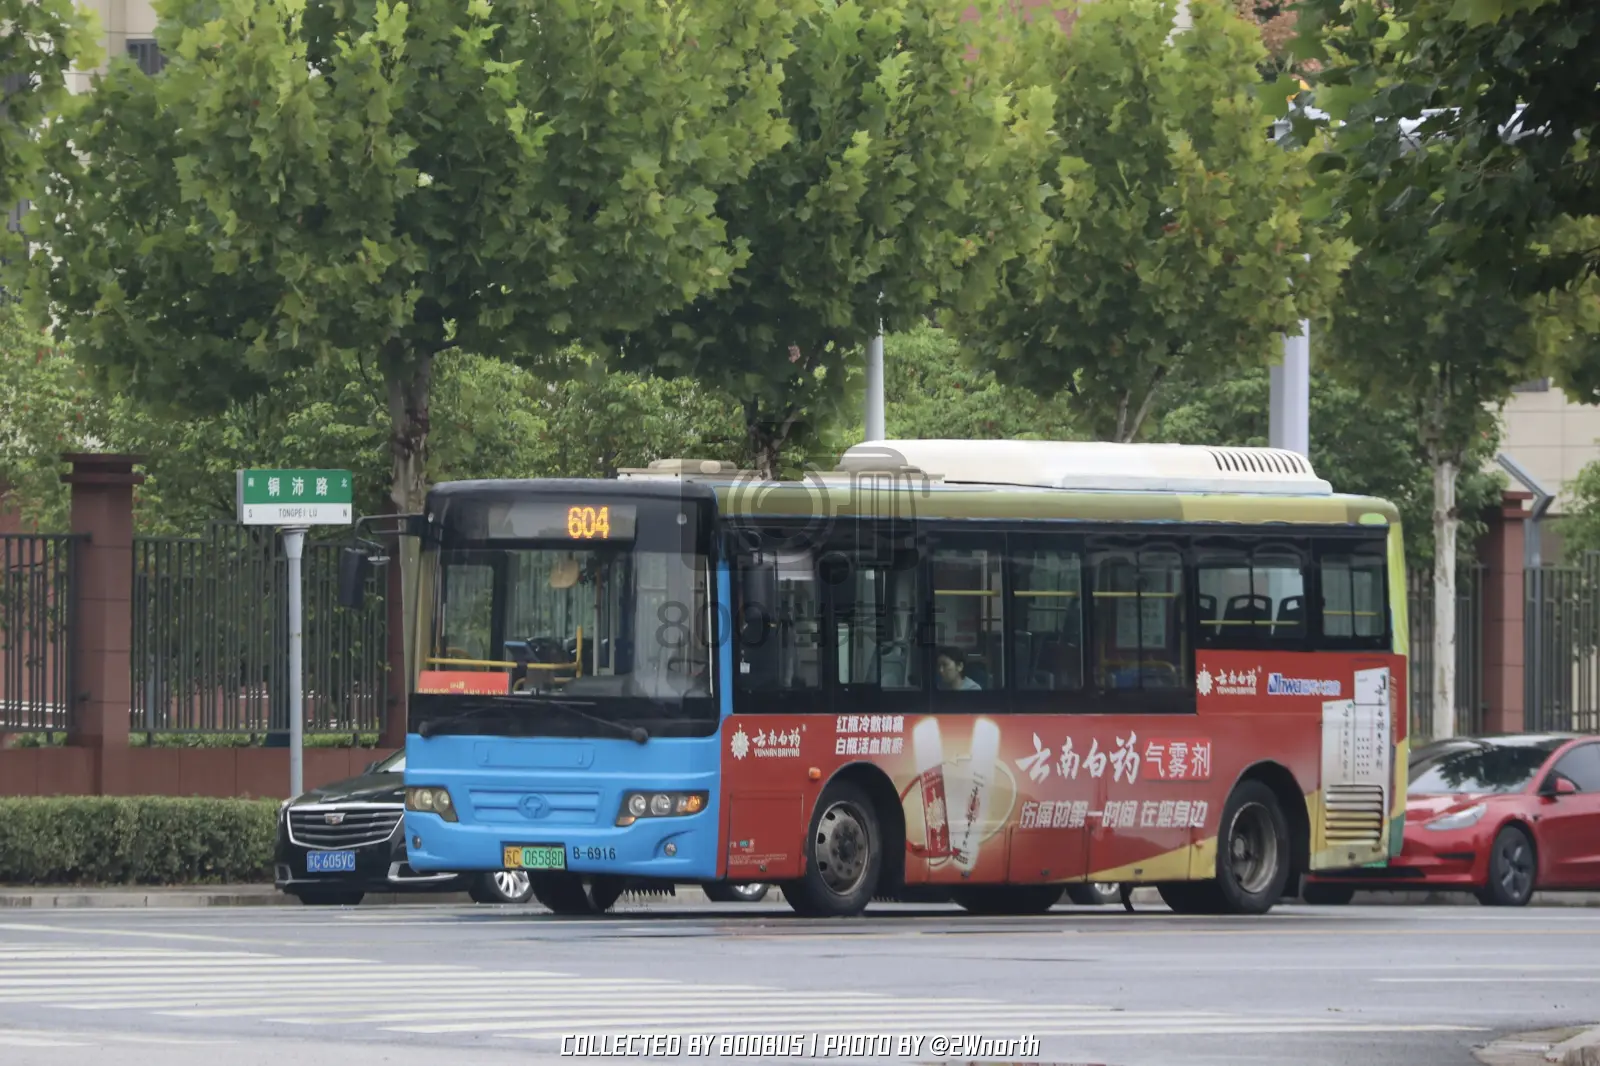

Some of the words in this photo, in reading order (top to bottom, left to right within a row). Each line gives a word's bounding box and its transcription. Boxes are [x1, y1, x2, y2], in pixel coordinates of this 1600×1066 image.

[267, 476, 329, 497] 铜沛路
[340, 477, 348, 488] 北
[248, 508, 253, 518] S
[278, 508, 306, 518] TONGPEI
[308, 508, 318, 518] LU
[342, 508, 348, 517] N
[567, 505, 610, 540] 604
[752, 726, 801, 748] 云南白药
[1014, 729, 1141, 785] 云南白药
[1145, 741, 1212, 778] 气雾剂
[572, 845, 617, 861] B-6916
